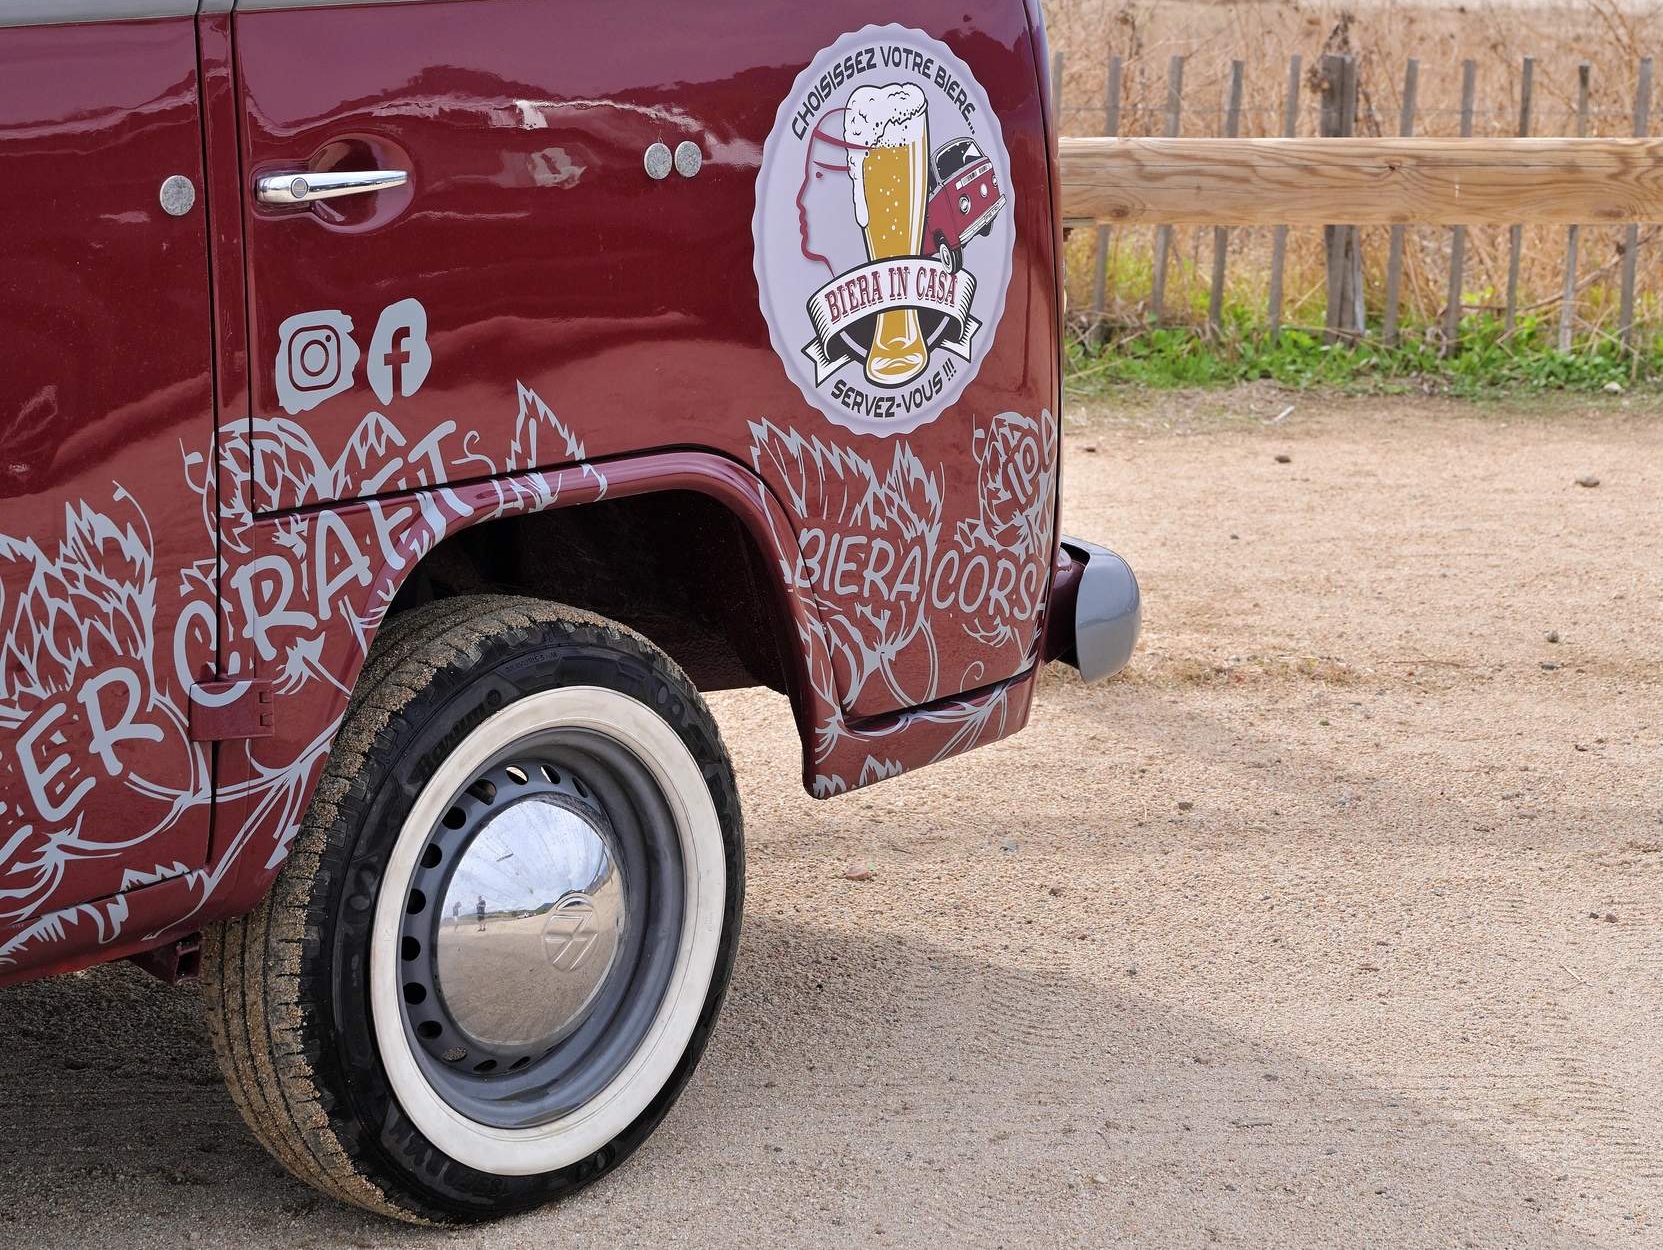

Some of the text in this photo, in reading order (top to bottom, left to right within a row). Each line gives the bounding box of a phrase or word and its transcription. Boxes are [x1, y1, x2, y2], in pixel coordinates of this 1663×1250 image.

[791, 47, 877, 141] CHOISISSEZ
[879, 45, 934, 80] VOTRE
[825, 266, 959, 324] BIERA IN CASA
[831, 371, 943, 418] SERVEZ-VOUS
[173, 420, 474, 707] CRAFT
[794, 527, 921, 602] BIERA
